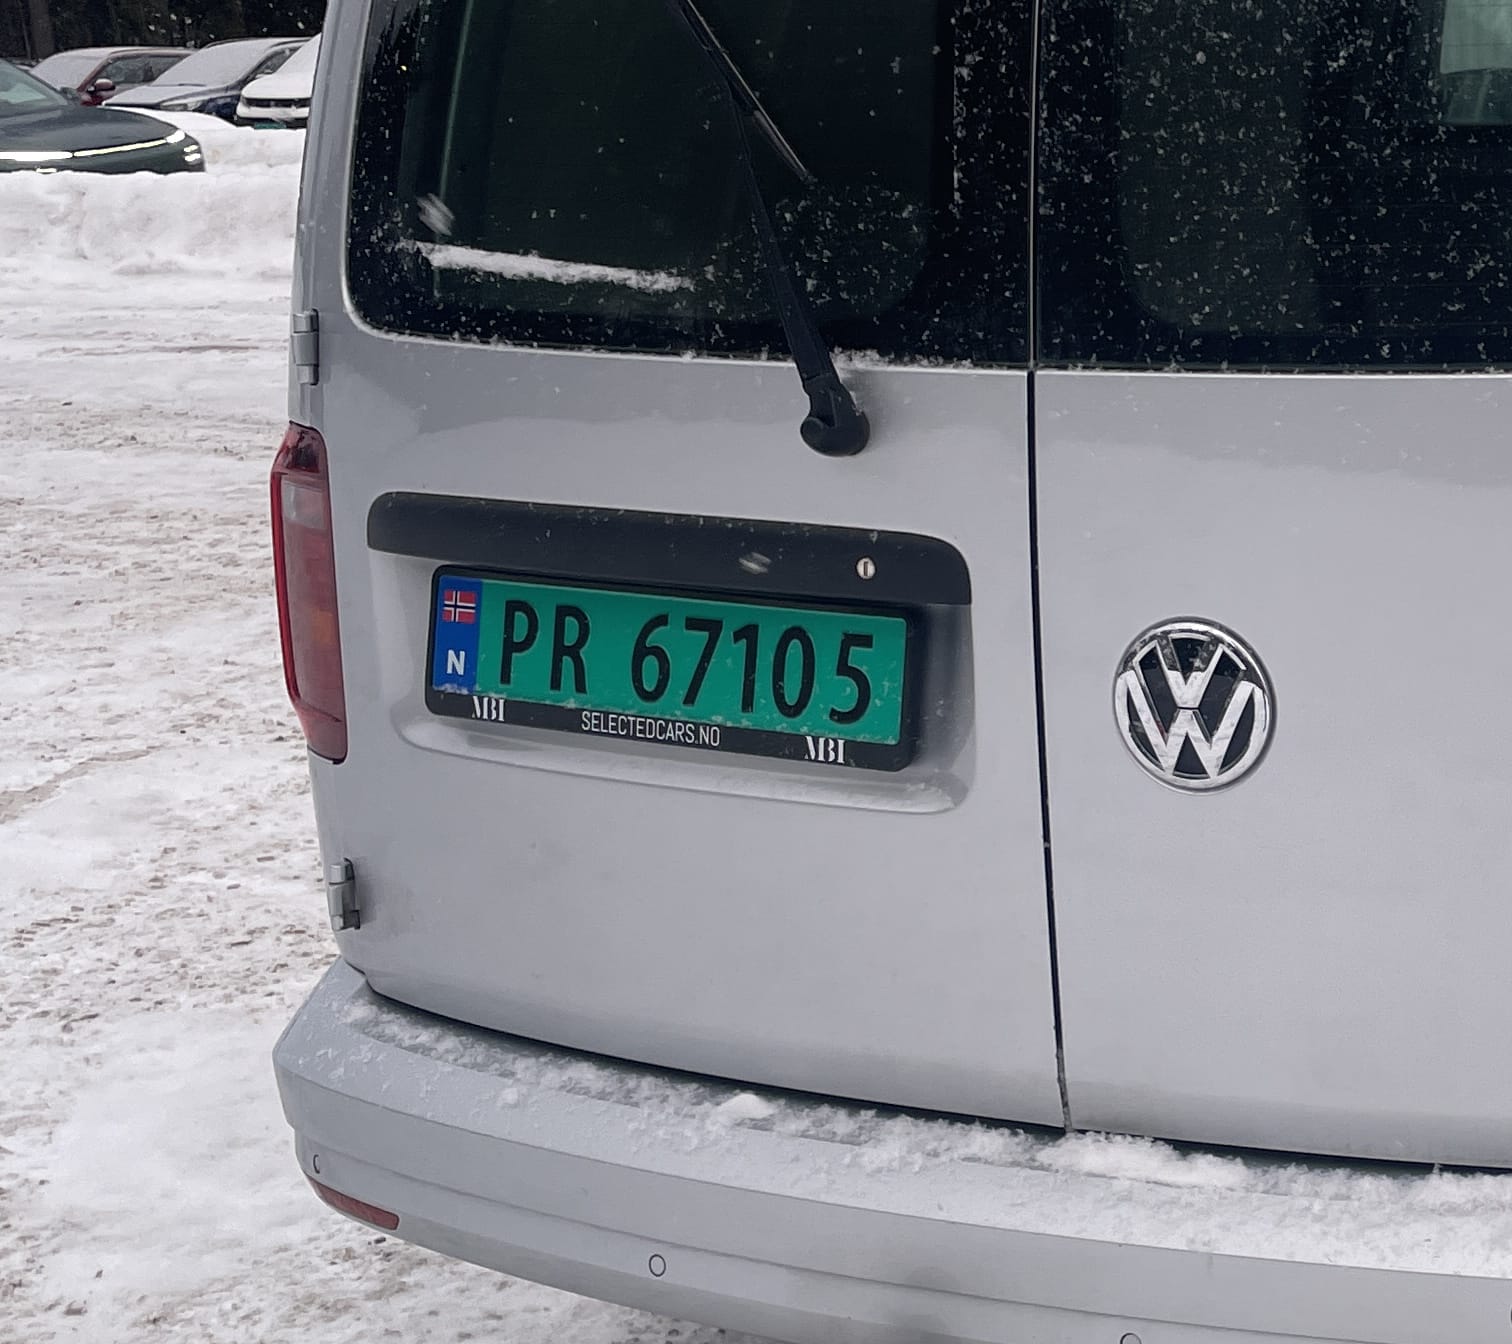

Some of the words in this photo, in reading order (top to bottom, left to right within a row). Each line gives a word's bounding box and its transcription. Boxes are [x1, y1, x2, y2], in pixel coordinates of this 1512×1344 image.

[446, 649, 466, 676] N
[500, 599, 591, 695] PR
[631, 614, 875, 725] 67105
[581, 710, 721, 747] SELECTEDCARS.NO
[1113, 617, 1275, 793] VW
